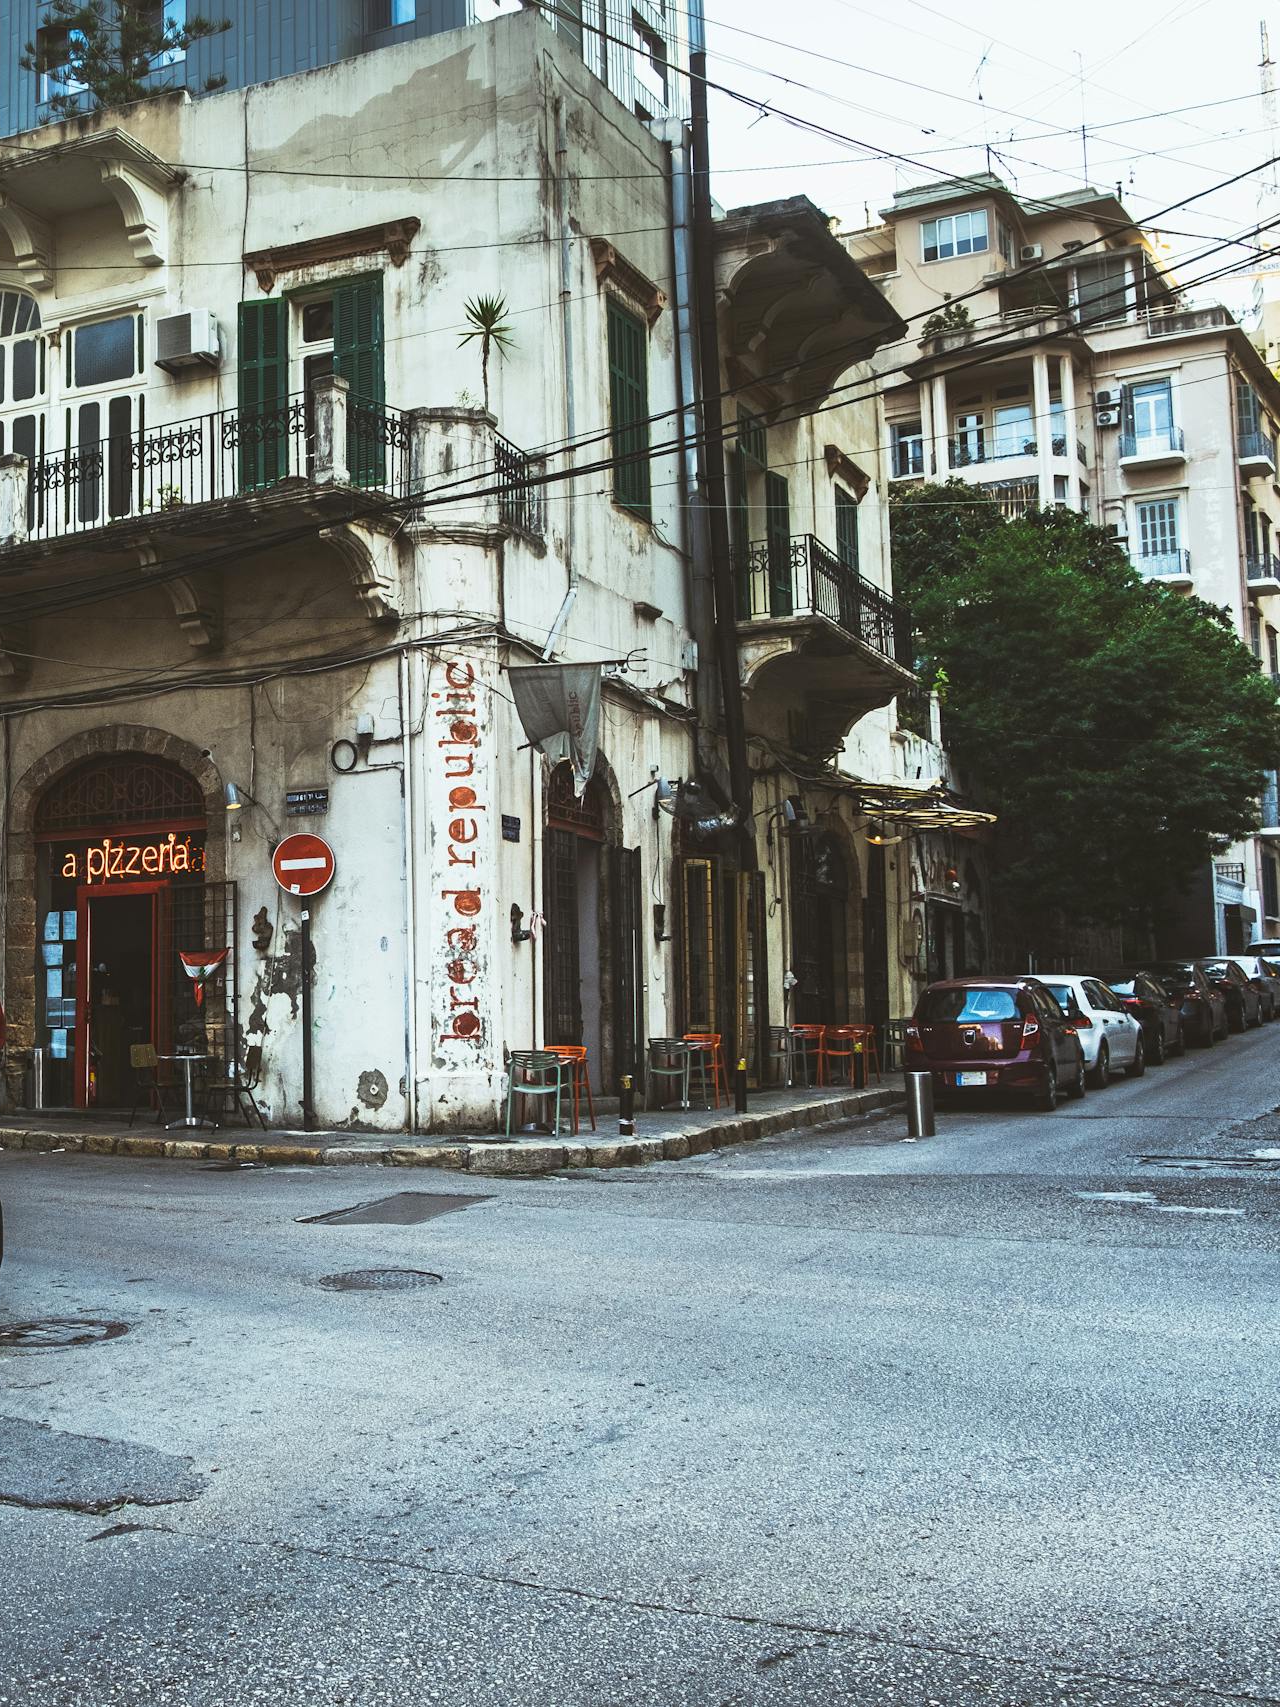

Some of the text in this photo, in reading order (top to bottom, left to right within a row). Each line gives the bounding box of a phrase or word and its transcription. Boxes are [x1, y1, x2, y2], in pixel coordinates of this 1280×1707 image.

[62, 832, 190, 885] a pizzeria
[431, 661, 486, 1047] bread republic
